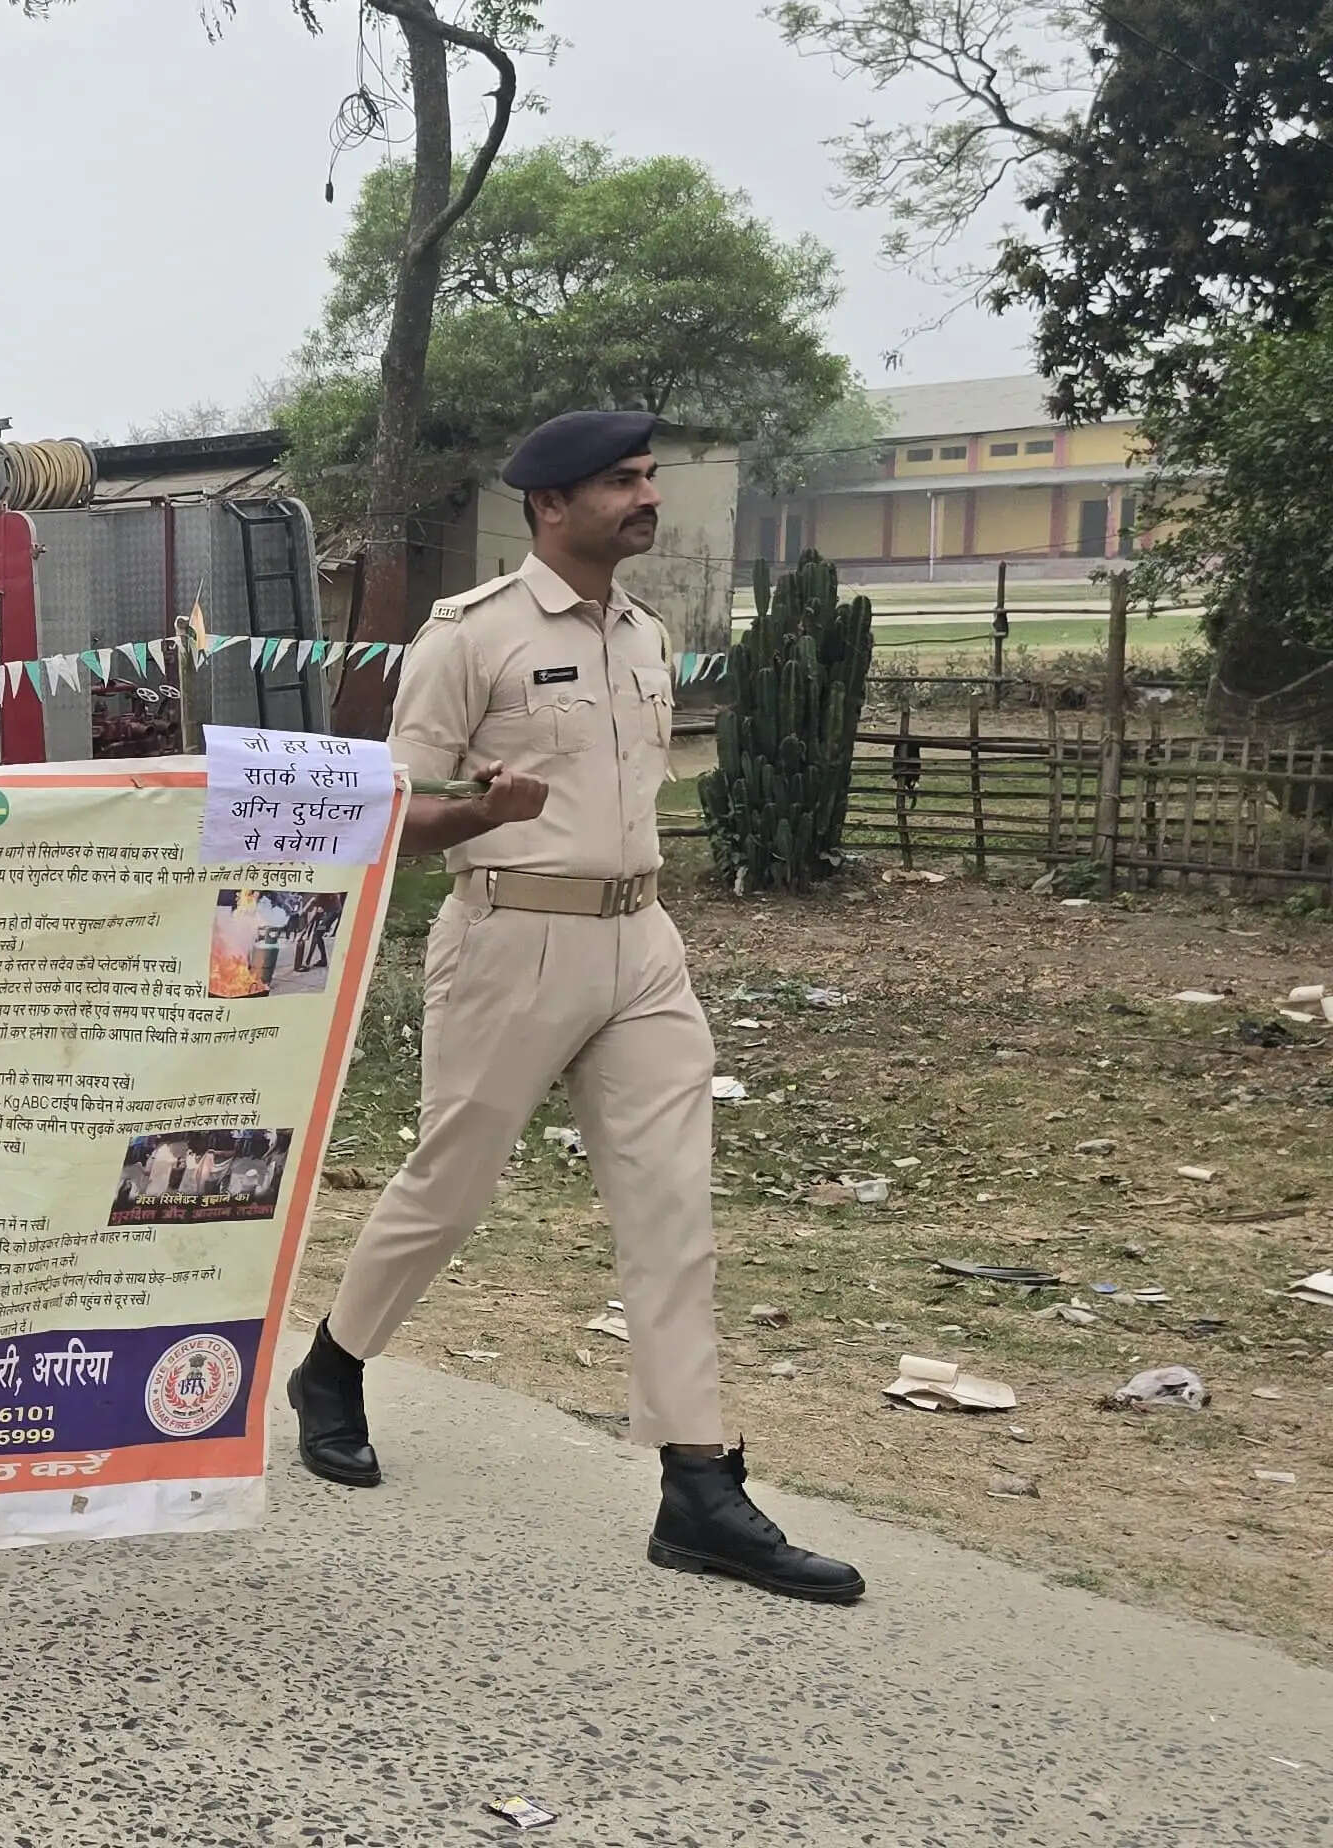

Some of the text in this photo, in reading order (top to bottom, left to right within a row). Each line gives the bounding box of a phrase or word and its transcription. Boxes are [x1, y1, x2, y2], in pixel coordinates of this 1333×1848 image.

[241, 733, 351, 756] जो हर पल
[243, 763, 359, 788] सतर्क रहेगा
[232, 796, 366, 825] अग्नि दुर्घटना
[5, 842, 24, 861] धागे
[26, 842, 37, 860] से
[38, 841, 81, 860] सिलेण्डर
[83, 841, 93, 859] के
[96, 846, 117, 860] साथ
[143, 846, 158, 860] कर
[244, 829, 261, 852] से
[19, 1069, 31, 1086] के
[33, 1072, 53, 1088] साथ
[75, 1074, 110, 1090] अवश्य
[3, 1096, 20, 1112] Kg
[22, 1096, 49, 1110] ABC
[8, 1213, 18, 1231] में
[19, 1218, 28, 1232] न
[208, 1341, 222, 1352] TO
[32, 1337, 114, 1387] अररिया
[30, 1451, 112, 1478] करें
